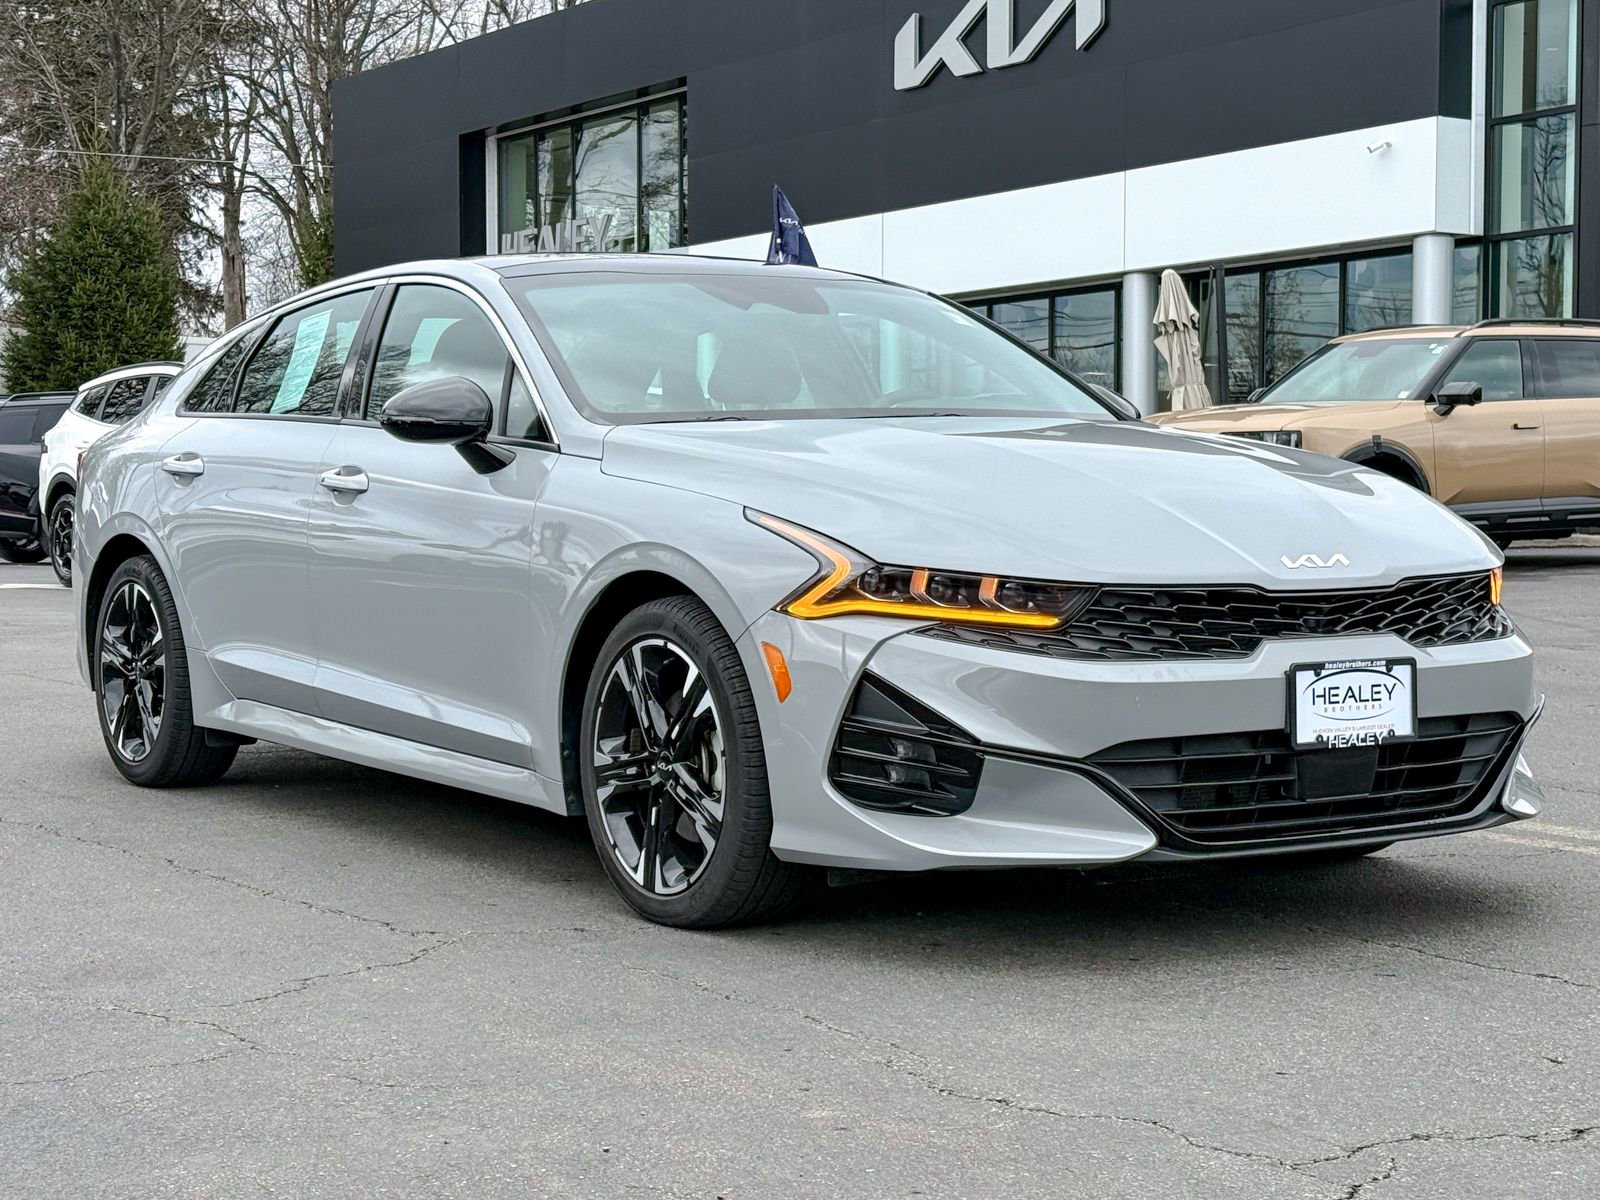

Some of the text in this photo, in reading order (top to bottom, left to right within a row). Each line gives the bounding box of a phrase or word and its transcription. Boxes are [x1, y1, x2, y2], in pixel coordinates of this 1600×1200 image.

[1280, 554, 1350, 569] KIA
[1324, 660, 1387, 669] healeybrothers.com
[1312, 683, 1397, 706] HEALEY
[1324, 704, 1382, 713] BROTHERS
[1328, 731, 1384, 749] HEALEY
